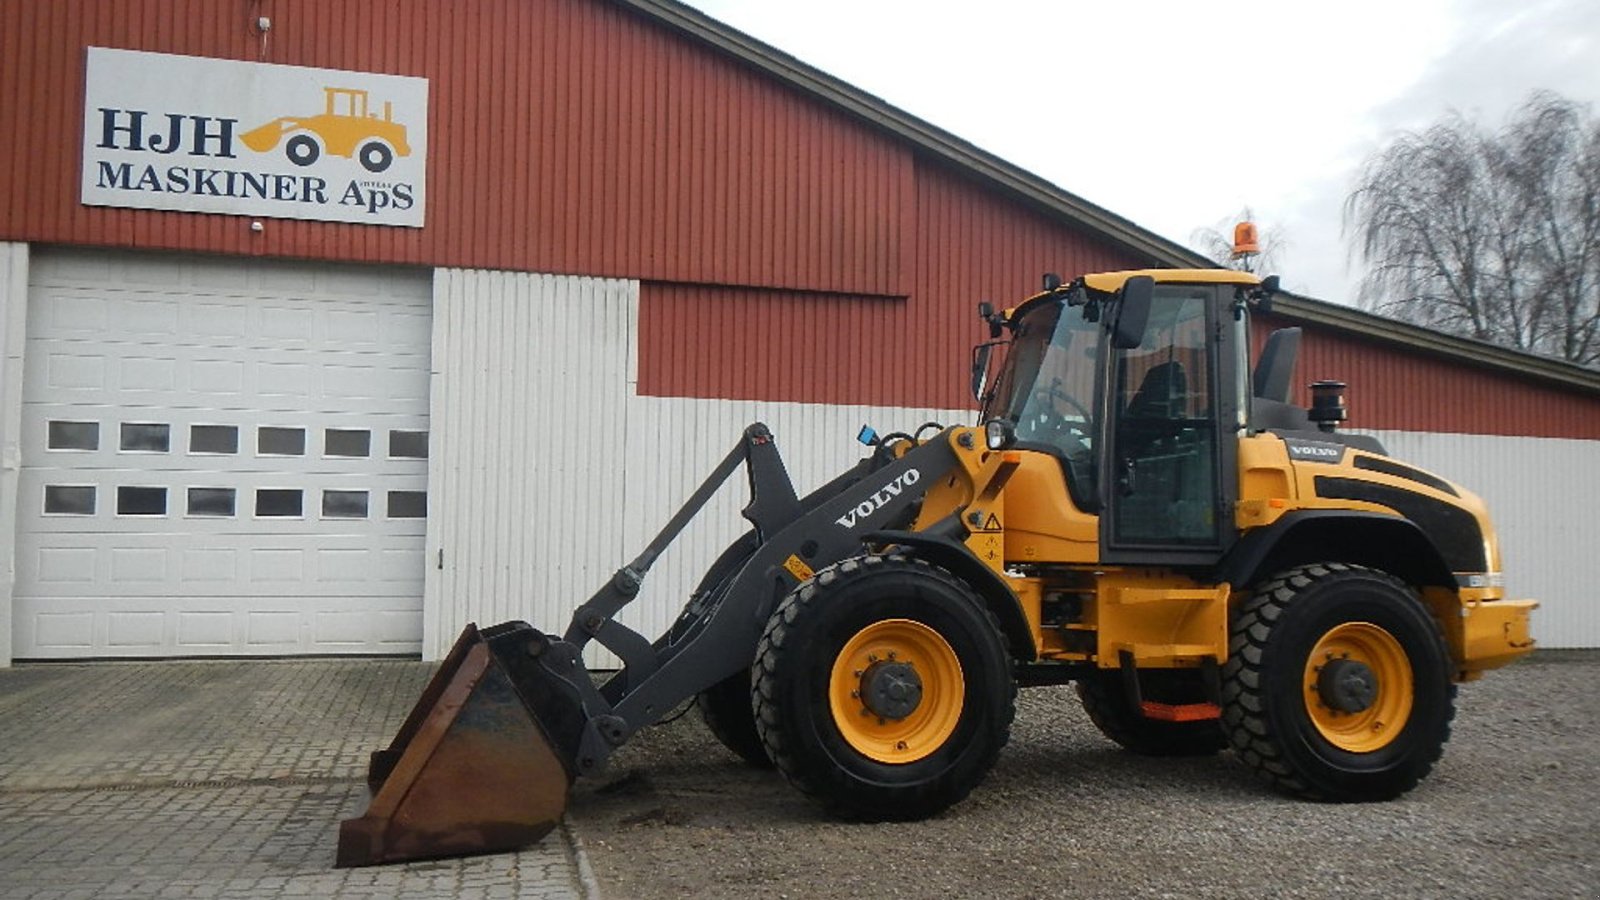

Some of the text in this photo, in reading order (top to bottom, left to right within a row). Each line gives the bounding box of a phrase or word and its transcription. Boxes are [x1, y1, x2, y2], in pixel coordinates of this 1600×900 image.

[96, 107, 238, 158] HJH
[96, 160, 414, 214] MASKINER ApS
[1291, 446, 1338, 456] VOLVO
[834, 468, 920, 529] VOLVO
